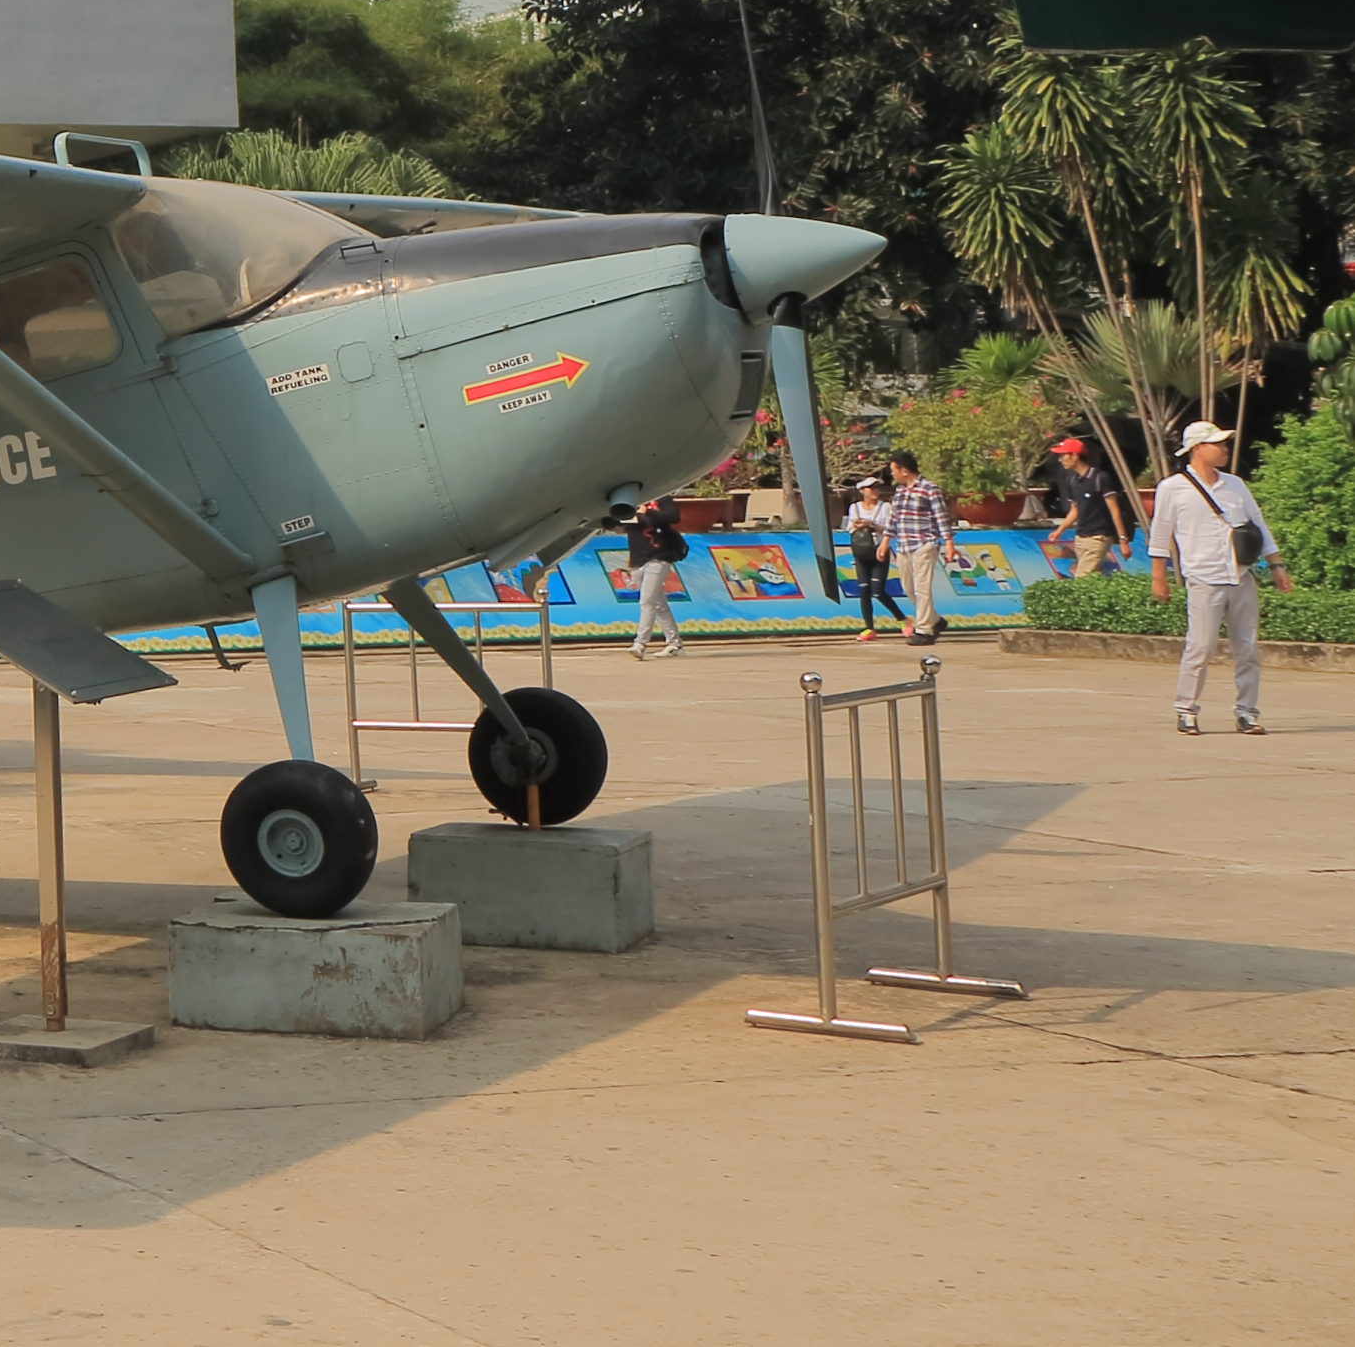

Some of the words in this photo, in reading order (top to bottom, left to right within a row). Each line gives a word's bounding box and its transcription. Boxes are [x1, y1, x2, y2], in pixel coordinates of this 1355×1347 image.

[489, 355, 530, 374] DANGER
[270, 373, 329, 395] REFUELING
[271, 374, 293, 386] ADD
[294, 365, 324, 380] TANK
[501, 398, 523, 412] KEEP
[524, 391, 549, 406] AWAY
[284, 517, 311, 534] STEP
